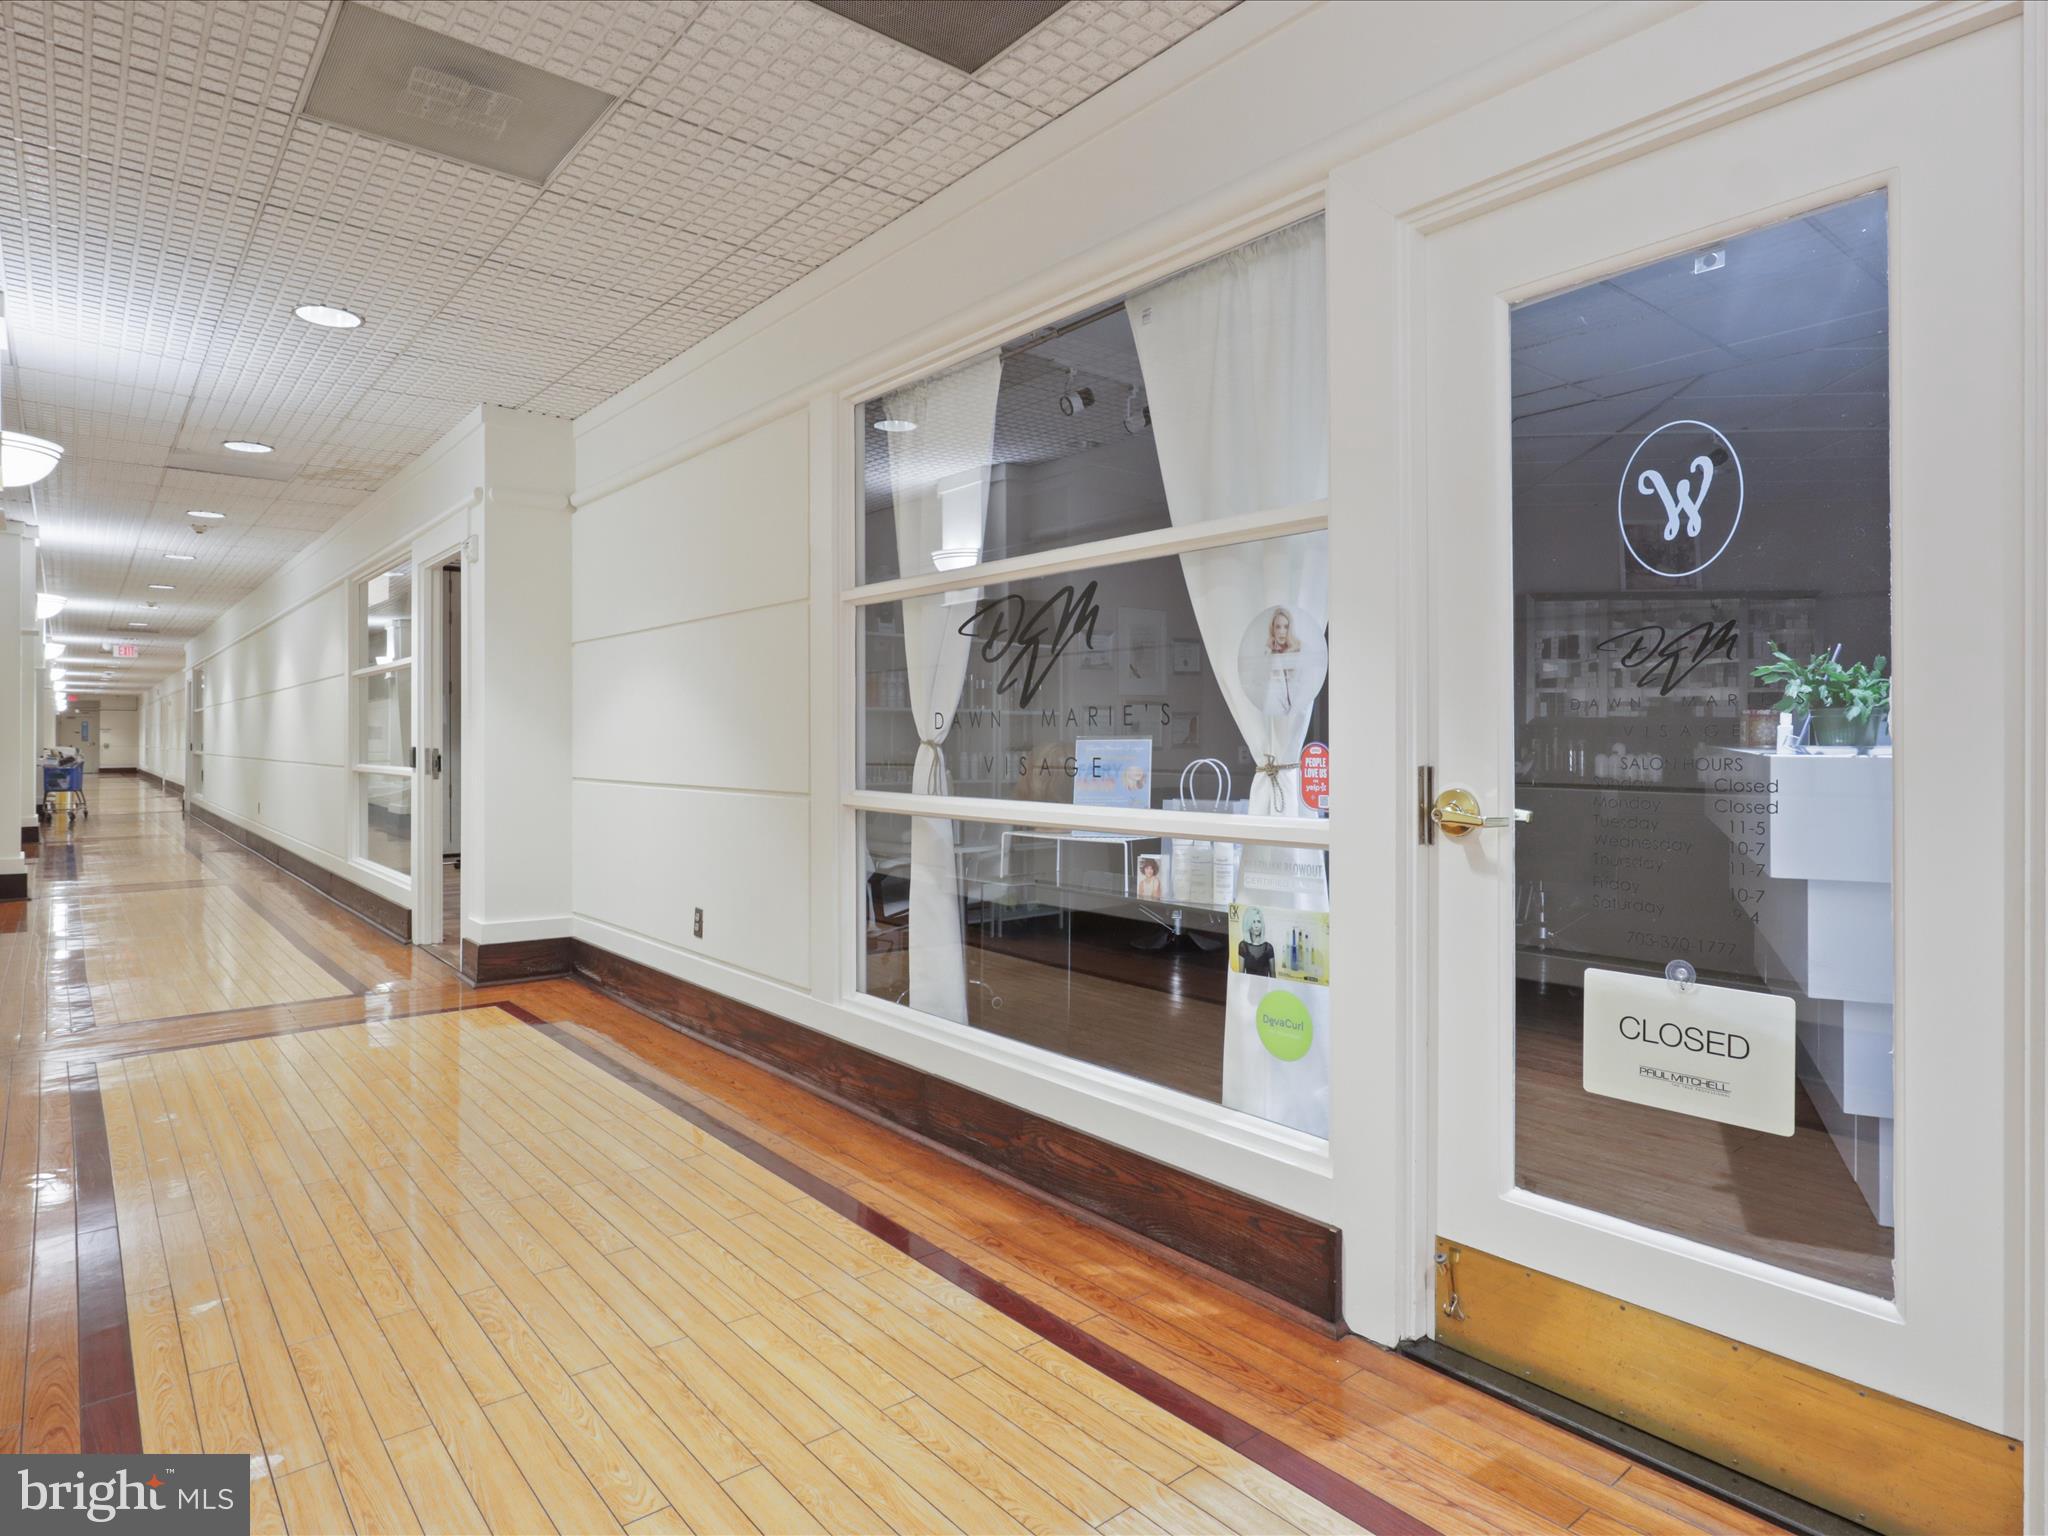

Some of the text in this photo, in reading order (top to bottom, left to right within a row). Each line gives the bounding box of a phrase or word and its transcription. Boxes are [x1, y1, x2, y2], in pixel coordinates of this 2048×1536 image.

[118, 645, 135, 656] EXIT
[1569, 697, 1642, 712] DAWN
[934, 702, 1172, 730] DAWN MARIE'S
[1622, 724, 1741, 738] VISAGE
[983, 756, 1102, 778] VISAGE
[1305, 757, 1326, 768] PEOPLE
[1620, 756, 1744, 772] SALON HOURS
[1304, 768, 1327, 779] LOVE US
[1714, 778, 1779, 794] Closed
[1593, 797, 1779, 815] Monday Closed
[1593, 814, 1766, 836] Tuesday 11-5
[1594, 834, 1766, 857] Wednesday 10-7
[1593, 853, 1766, 878] Thursday 11-7
[1593, 875, 1766, 904] Friday 10-7
[1592, 894, 1665, 920] Saturday
[1262, 1014, 1305, 1032] DevaCurl
[1619, 1015, 1751, 1061] CLOSED
[1639, 1066, 1669, 1081] PAUL
[1670, 1073, 1732, 1093] MITCHELL
